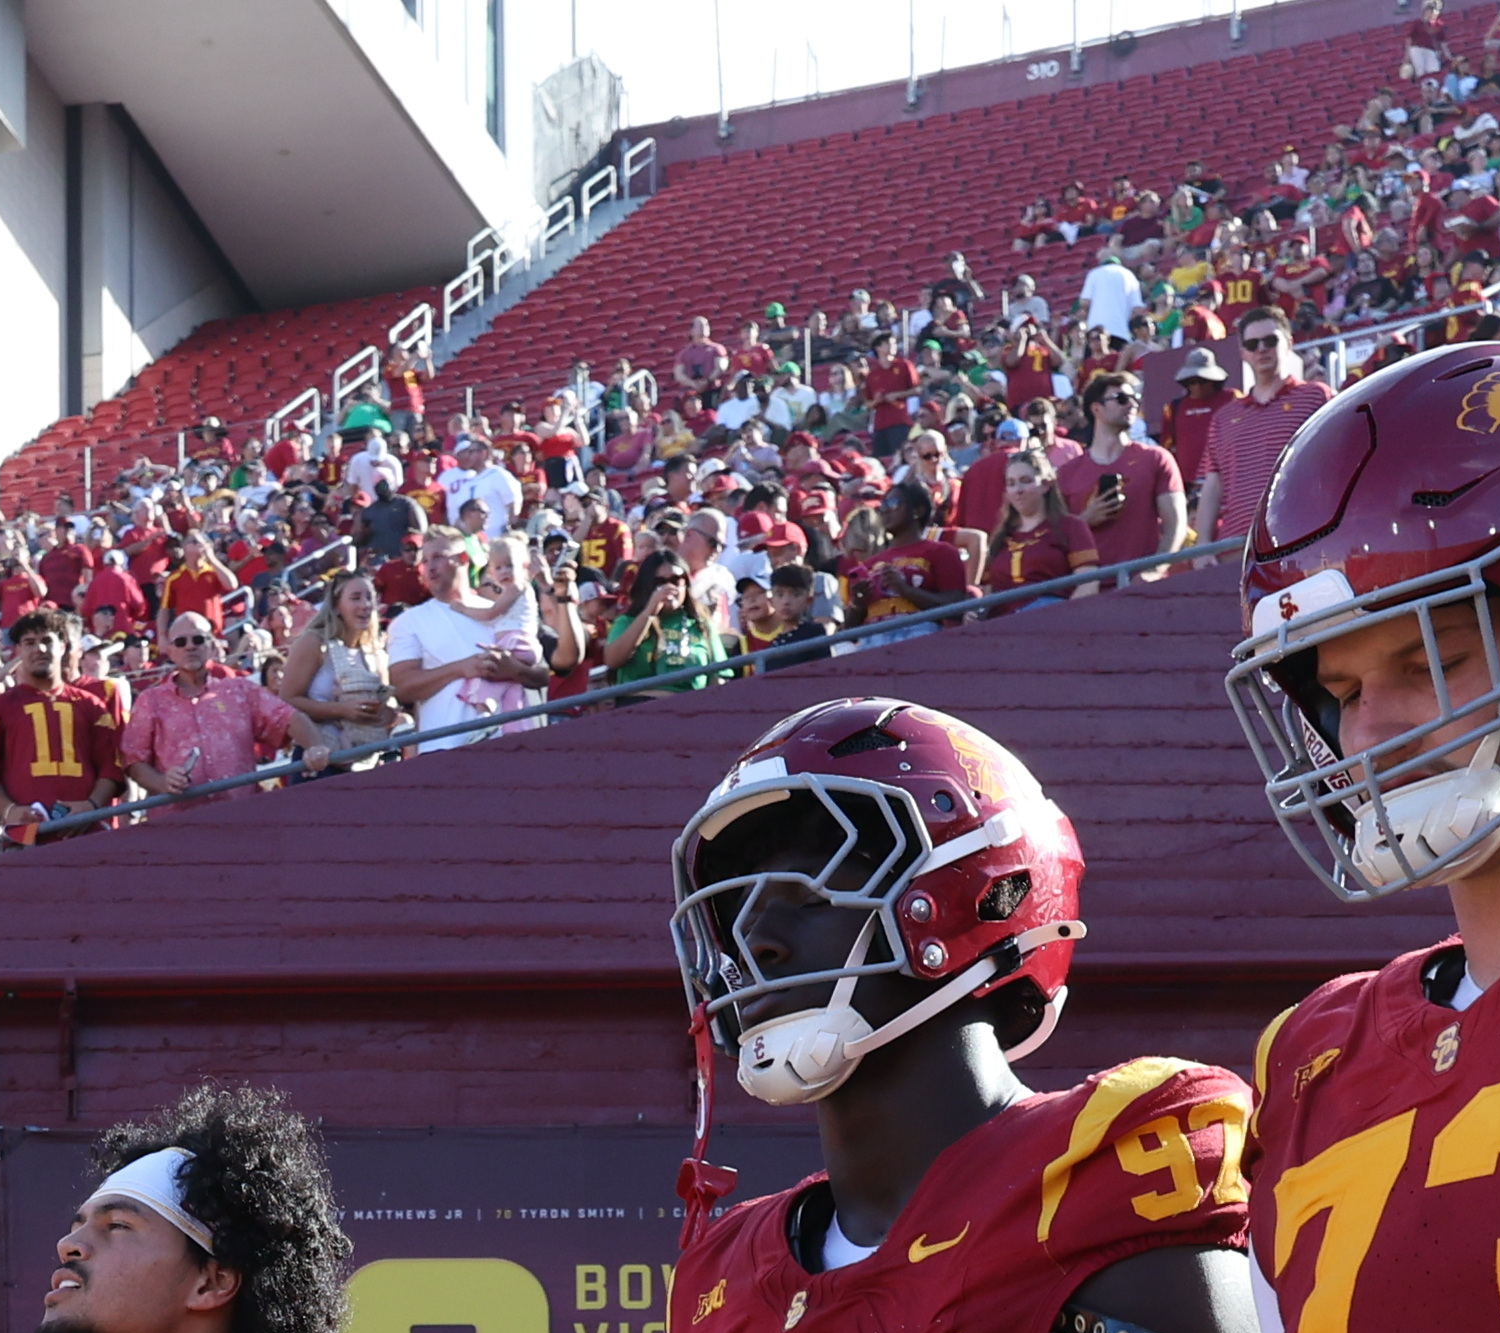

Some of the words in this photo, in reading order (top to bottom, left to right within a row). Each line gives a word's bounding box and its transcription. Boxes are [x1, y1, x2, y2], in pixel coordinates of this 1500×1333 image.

[1026, 60, 1059, 80] 310
[1226, 279, 1253, 304] 10
[24, 702, 83, 777] 11
[1431, 1023, 1458, 1073] SC
[445, 1208, 464, 1220] JR
[520, 1208, 571, 1220] TYRON
[577, 1207, 626, 1219] SMITH
